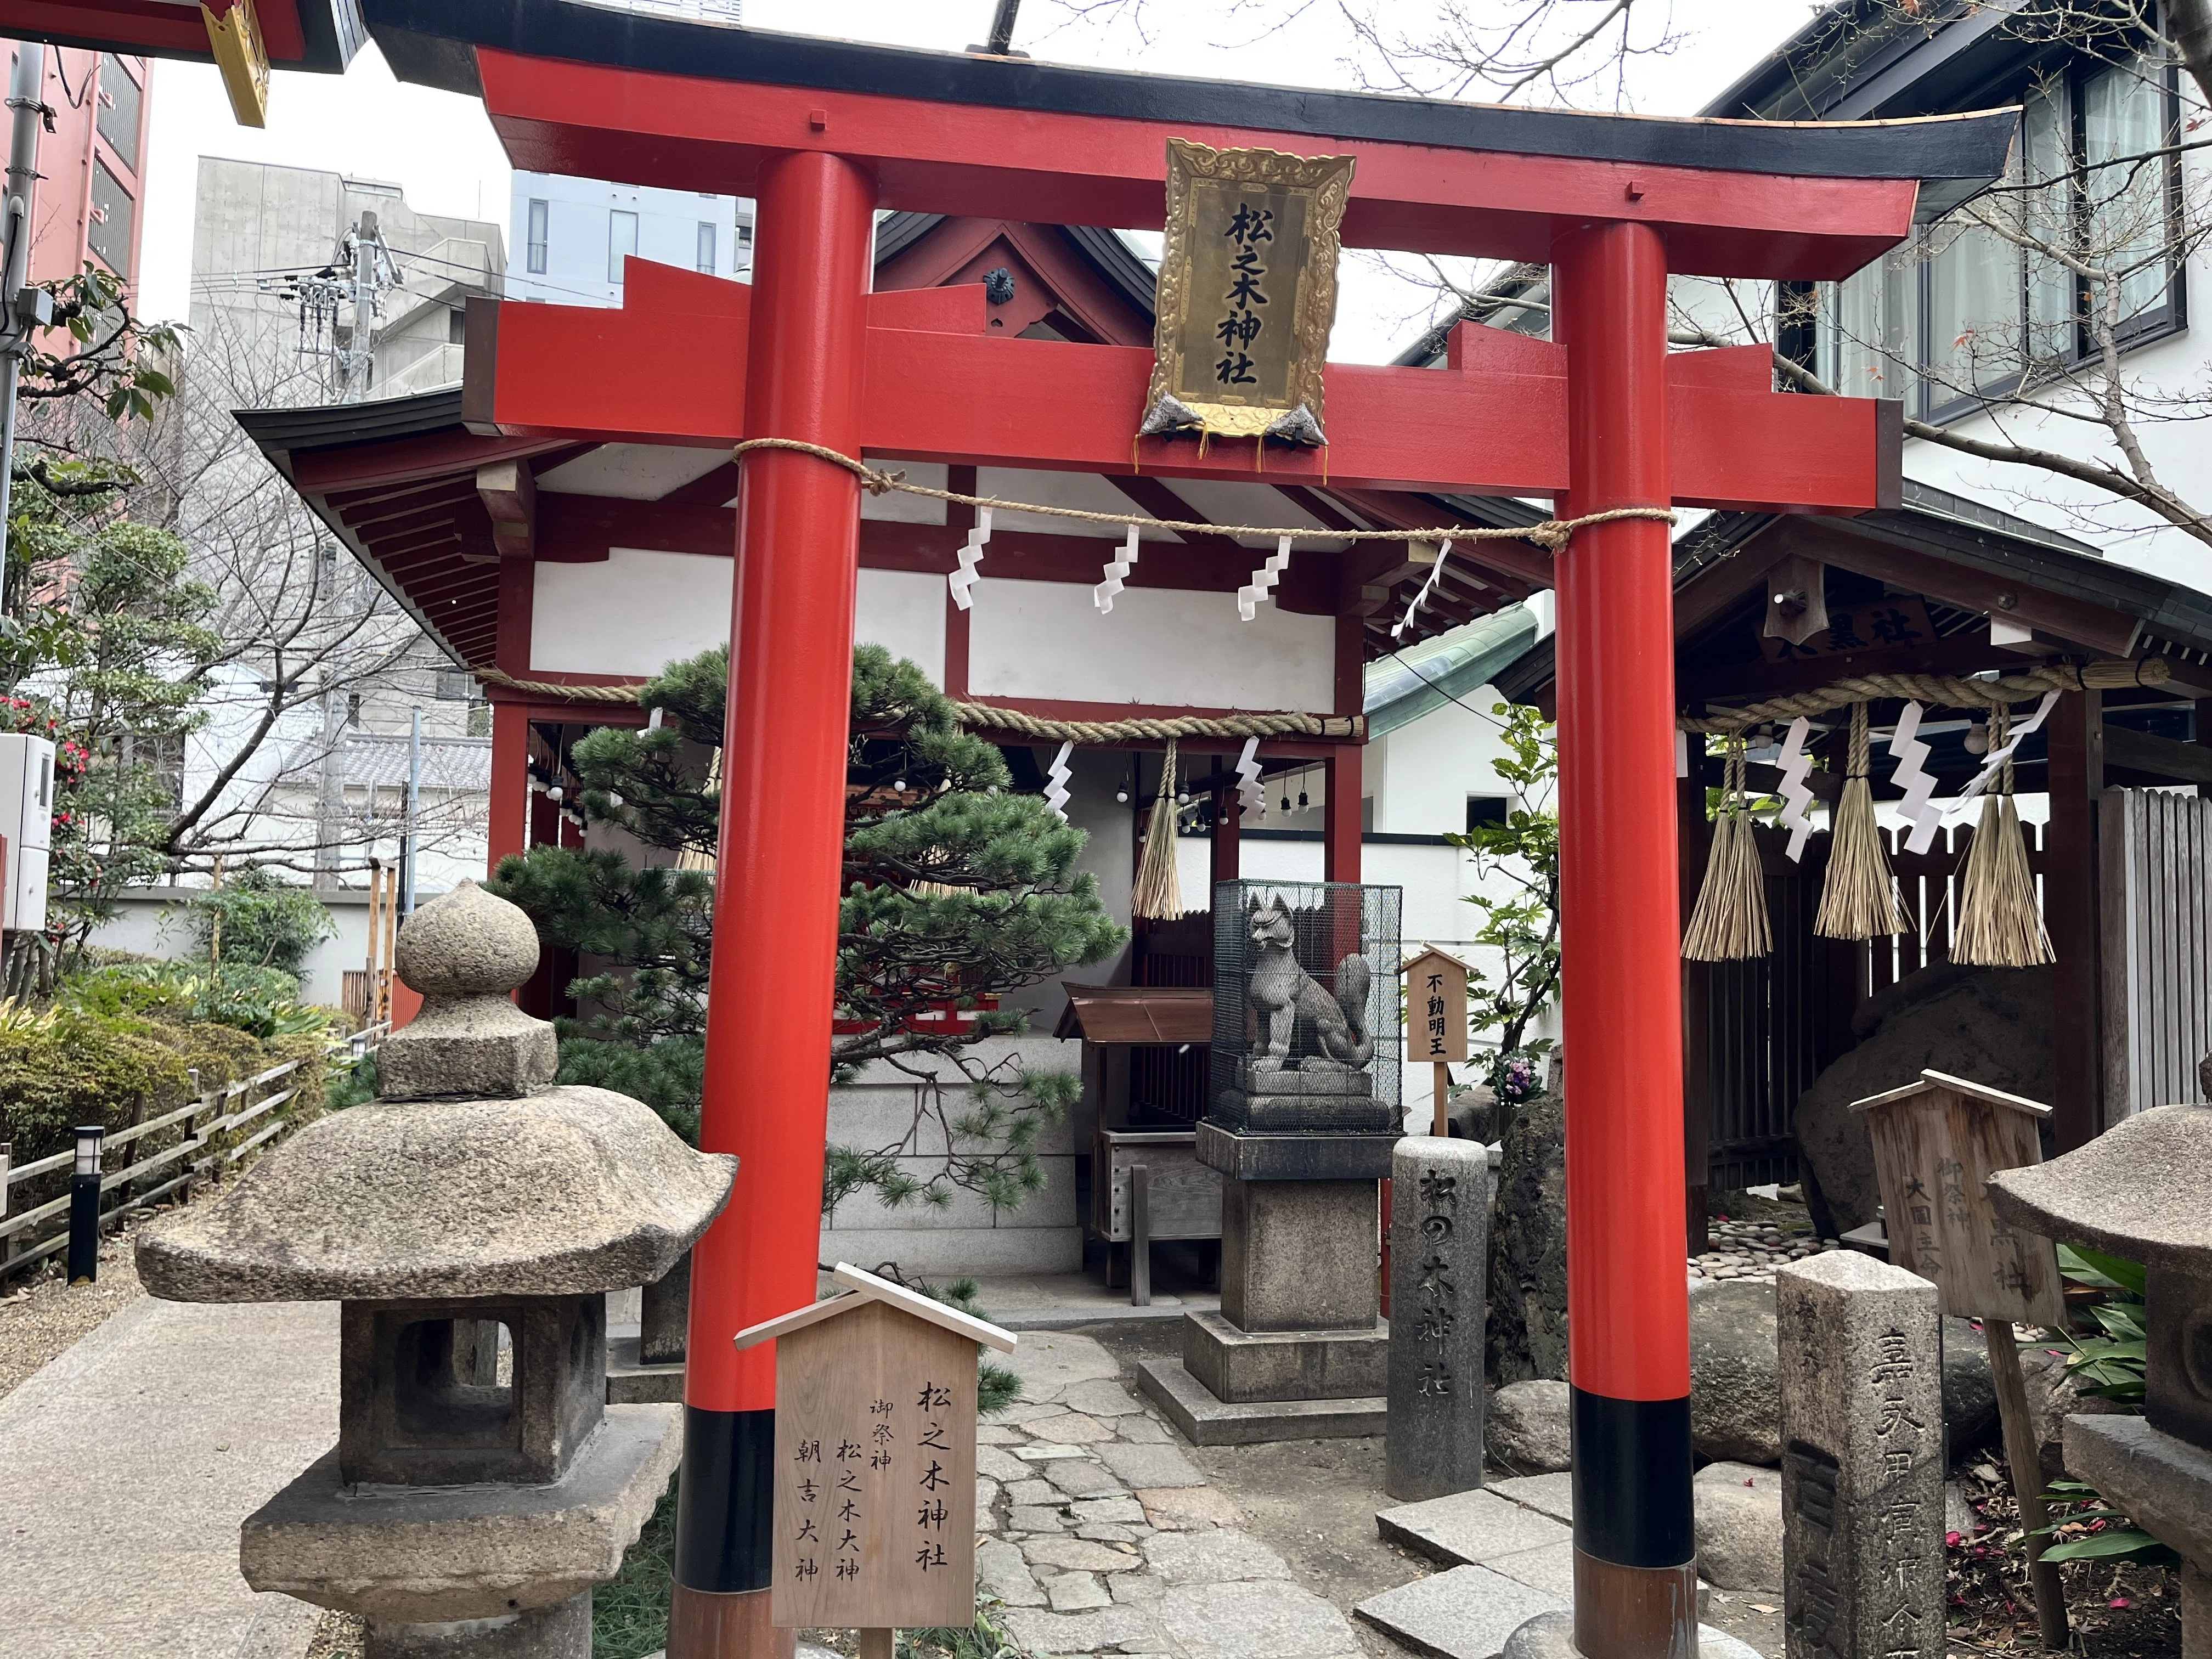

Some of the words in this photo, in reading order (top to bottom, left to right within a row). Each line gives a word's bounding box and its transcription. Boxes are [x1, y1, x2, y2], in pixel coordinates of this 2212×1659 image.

[1216, 202, 1274, 384] 松之木神社
[1426, 973, 1447, 1055] 不動明王
[1937, 1157, 1971, 1233] 御祭神
[1415, 1169, 1457, 1397] 松の木神社
[870, 1399, 894, 1472] 御祭神
[915, 1381, 952, 1572] 松之木神社
[794, 1438, 822, 1582] 朝吉大神
[836, 1438, 862, 1582] 松之木大神
